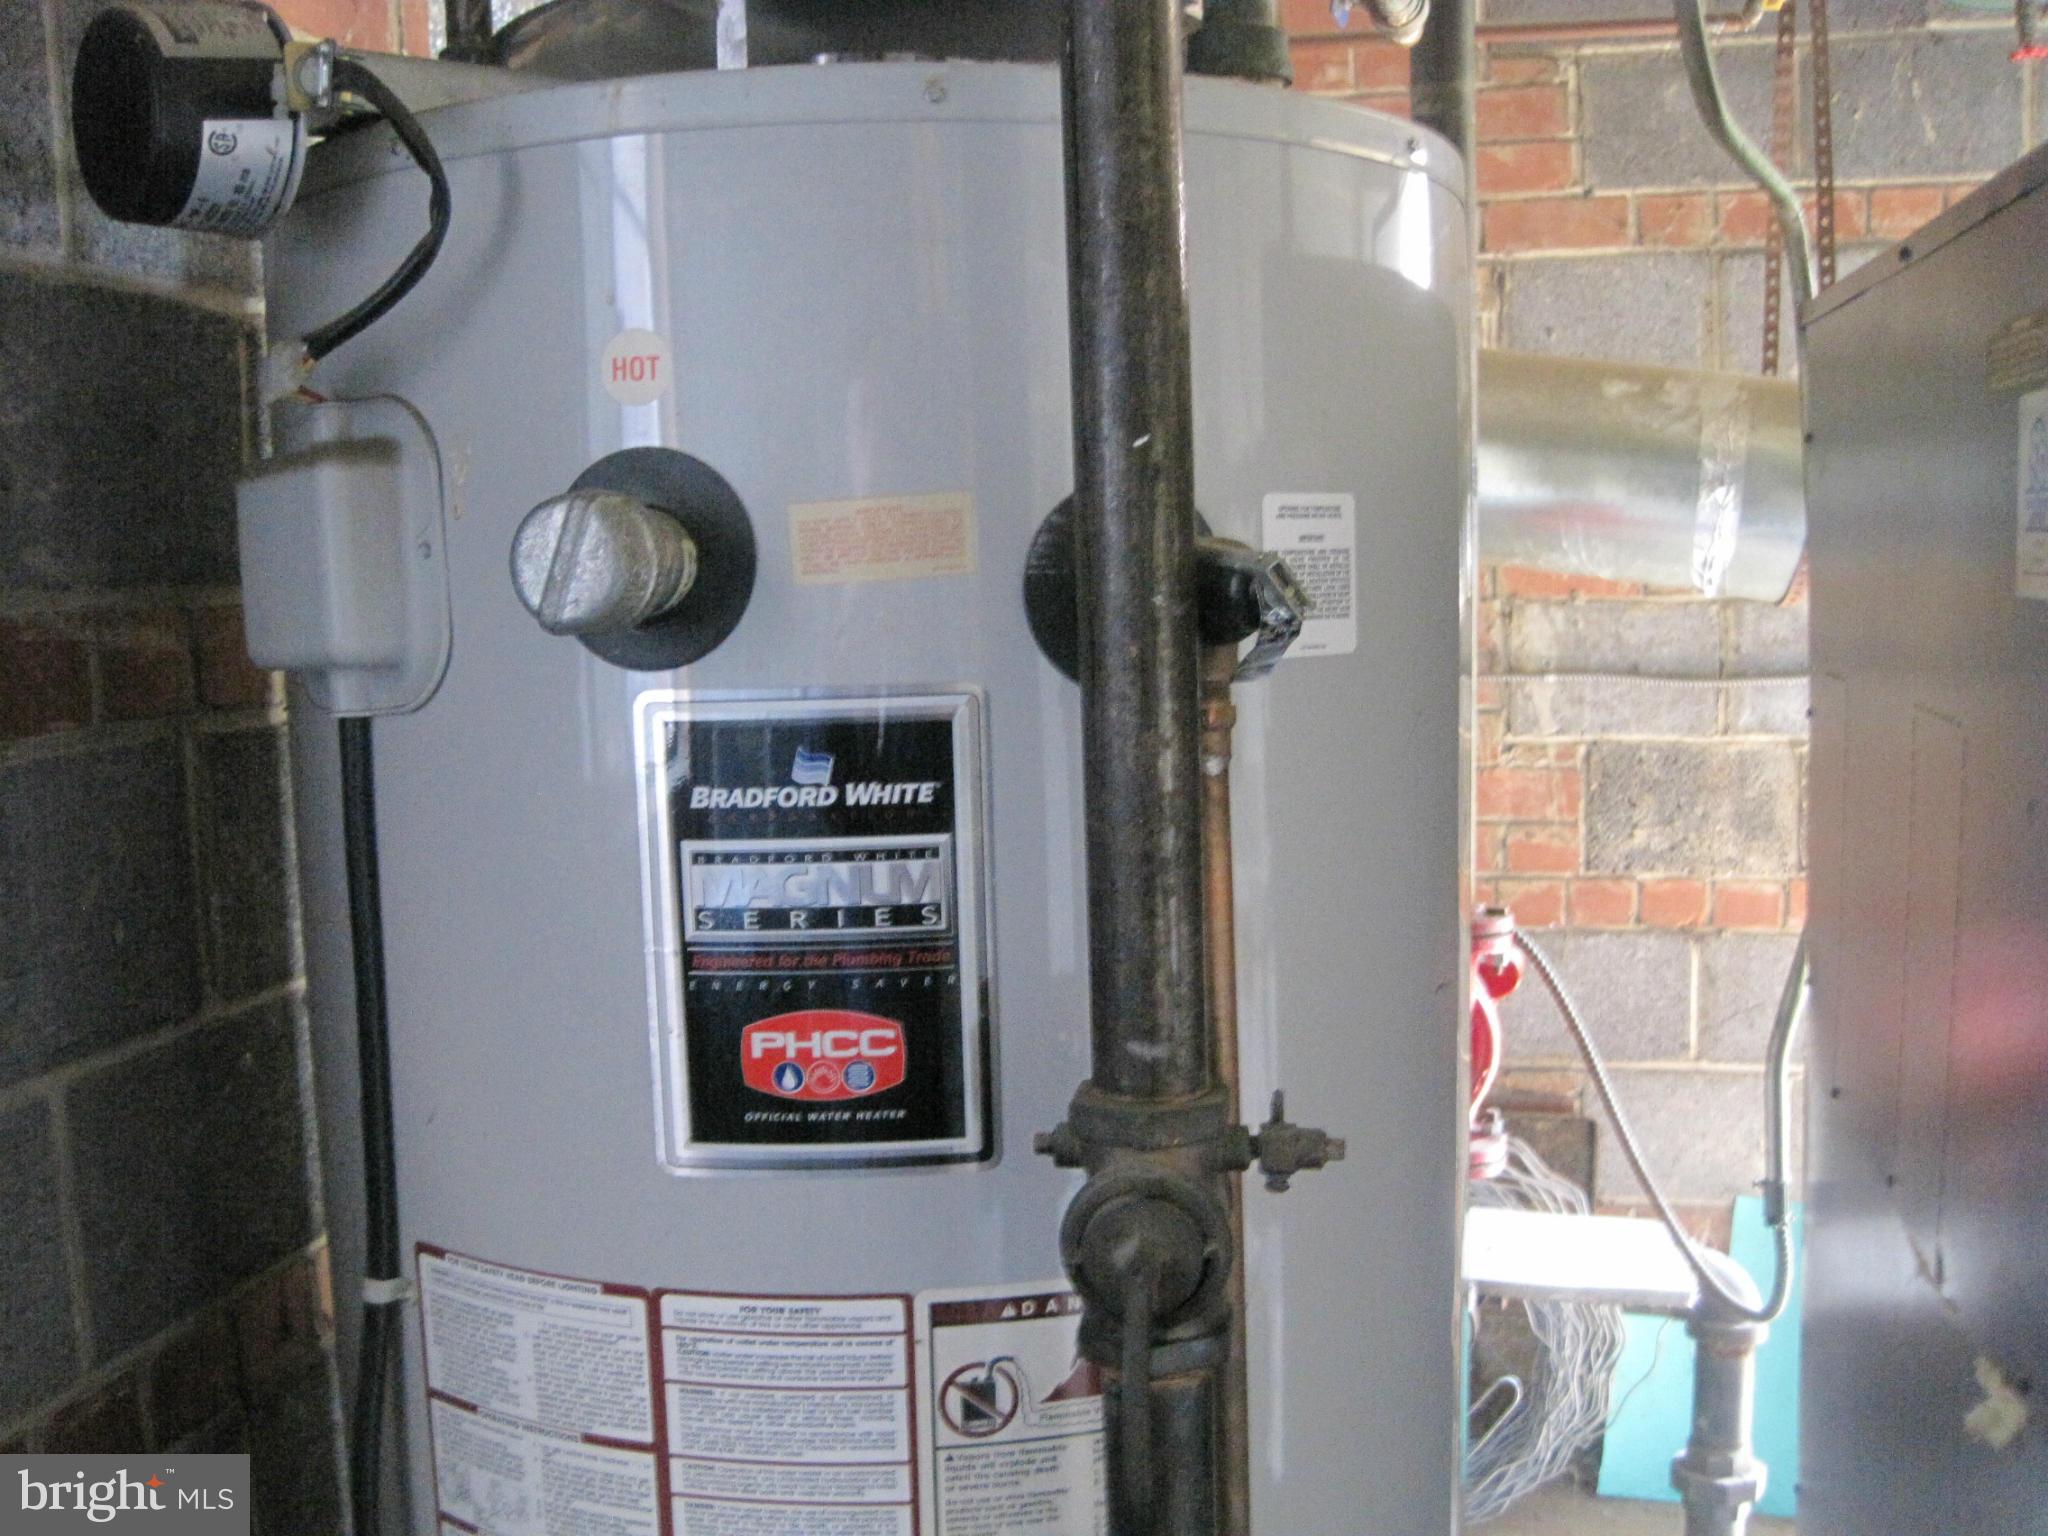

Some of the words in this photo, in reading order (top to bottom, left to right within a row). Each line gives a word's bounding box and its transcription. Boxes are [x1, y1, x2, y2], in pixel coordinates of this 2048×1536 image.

[611, 355, 661, 382] HOT
[690, 785, 839, 809] BRADFORD
[845, 781, 936, 806] WHITE
[696, 854, 833, 864] BRADFORD
[853, 850, 935, 862] WHITE
[698, 863, 942, 908] MAGNUM
[697, 905, 941, 931] SERIES
[777, 953, 800, 968] for
[832, 952, 902, 968] Plumbing
[907, 950, 951, 964] Trade
[689, 979, 817, 992] ENERGY
[851, 975, 957, 989] SAVER
[751, 1030, 897, 1059] PHCC
[744, 1111, 802, 1122] OFFICIAL
[807, 1110, 851, 1122] WATER
[856, 1109, 907, 1120] HEATER
[739, 1305, 758, 1314] FOR
[760, 1306, 785, 1314] YOUR
[788, 1306, 821, 1315] SAFETY
[1021, 1295, 1083, 1317] DAN
